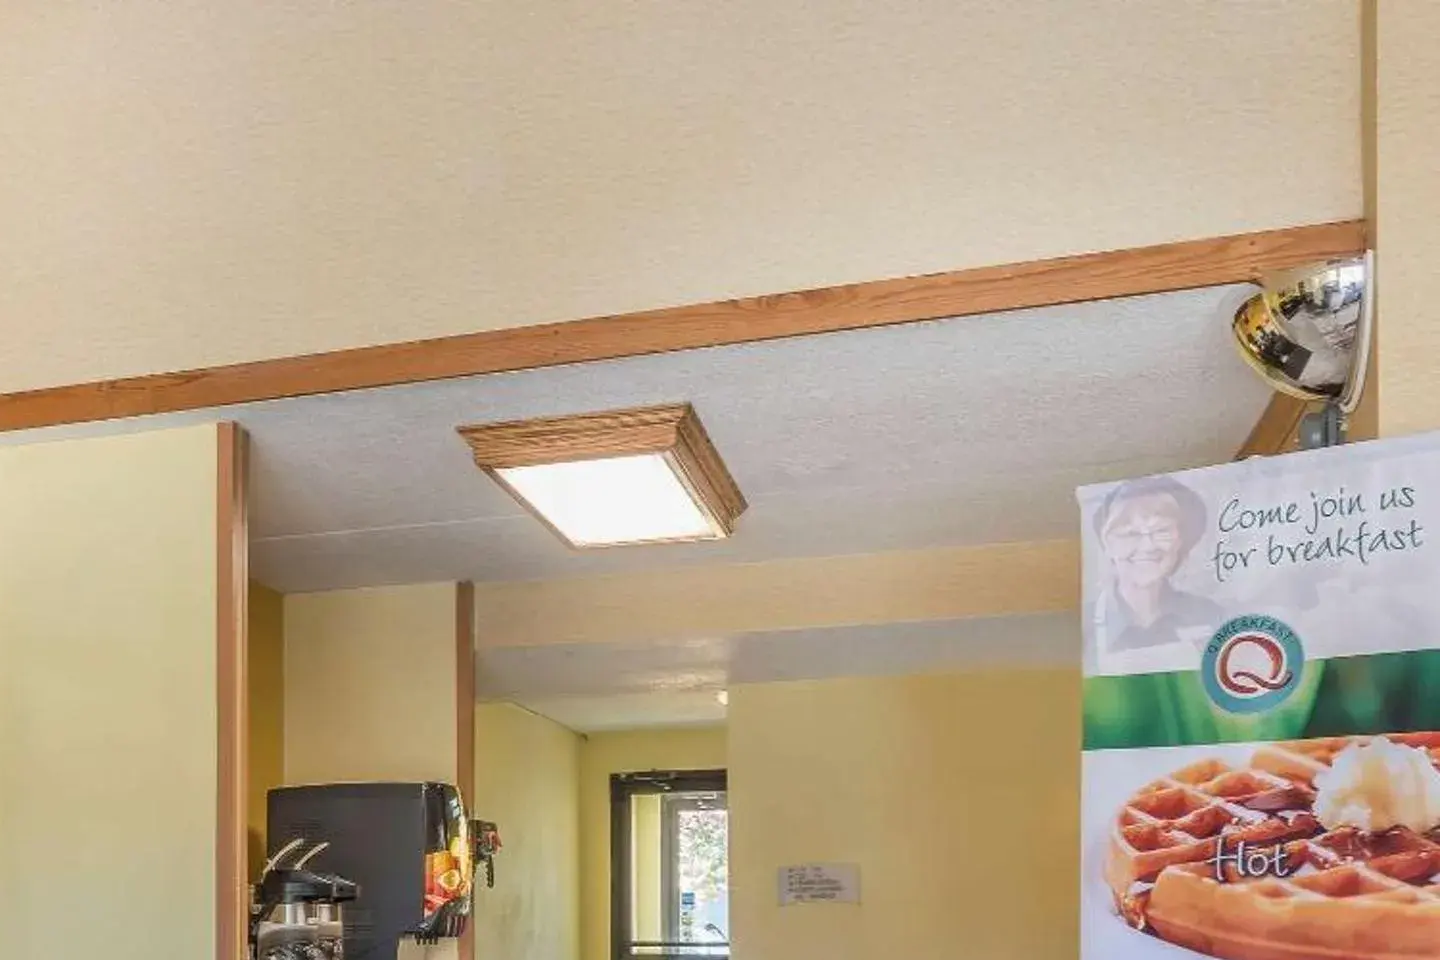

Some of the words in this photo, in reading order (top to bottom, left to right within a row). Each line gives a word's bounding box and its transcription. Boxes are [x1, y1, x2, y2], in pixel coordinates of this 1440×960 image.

[1218, 498, 1301, 533] Come
[1304, 487, 1366, 535] join
[1379, 486, 1416, 511] us
[1213, 540, 1257, 583] for
[1267, 519, 1425, 565] breakfast
[1218, 635, 1293, 694] Q
[1205, 838, 1290, 881] Hot
